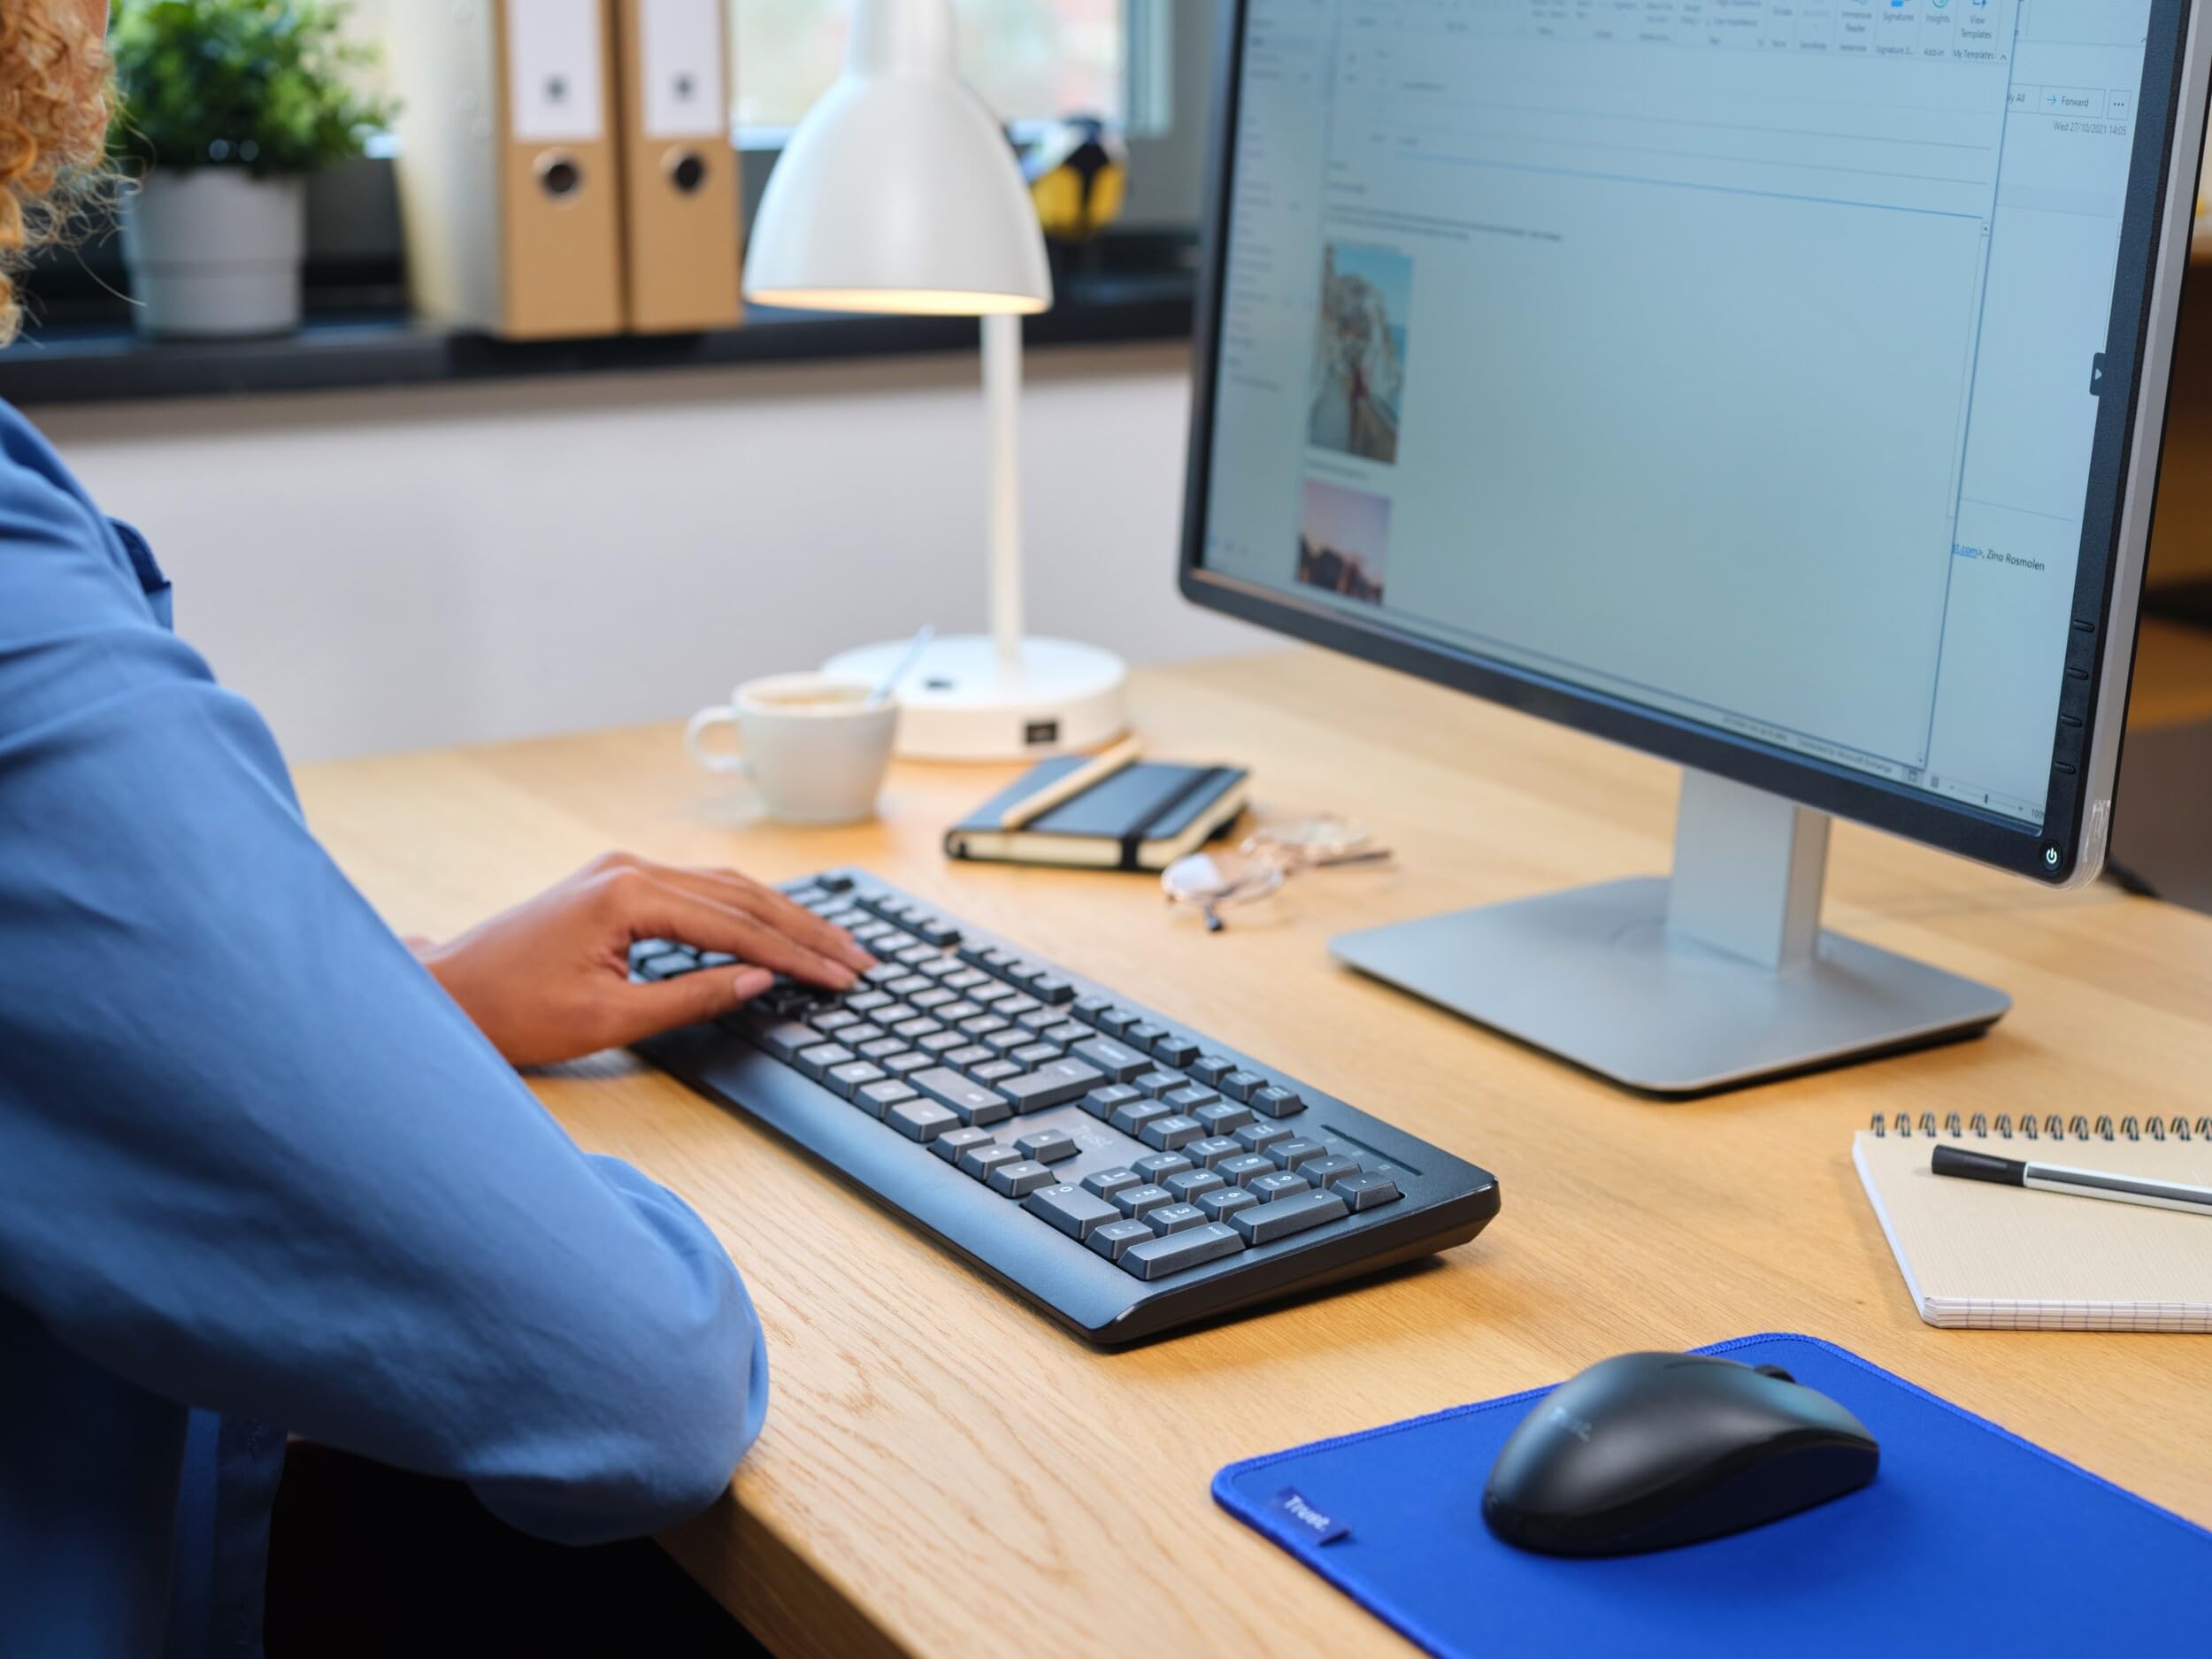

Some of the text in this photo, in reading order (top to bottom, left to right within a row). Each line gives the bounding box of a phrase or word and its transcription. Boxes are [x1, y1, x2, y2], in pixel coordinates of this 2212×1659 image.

[1882, 13, 1914, 23] Signatures
[1925, 13, 1950, 24] Insights
[1970, 16, 1985, 25] View
[1961, 28, 1992, 39] Templates
[1953, 50, 1993, 60] My Templates
[2016, 93, 2025, 103] All
[2061, 96, 2089, 107] Forward
[2053, 120, 2069, 132] Wed
[2070, 121, 2108, 134] 27/10/2021
[1986, 549, 2004, 563] Zino
[2005, 553, 2046, 572] Rosmolen
